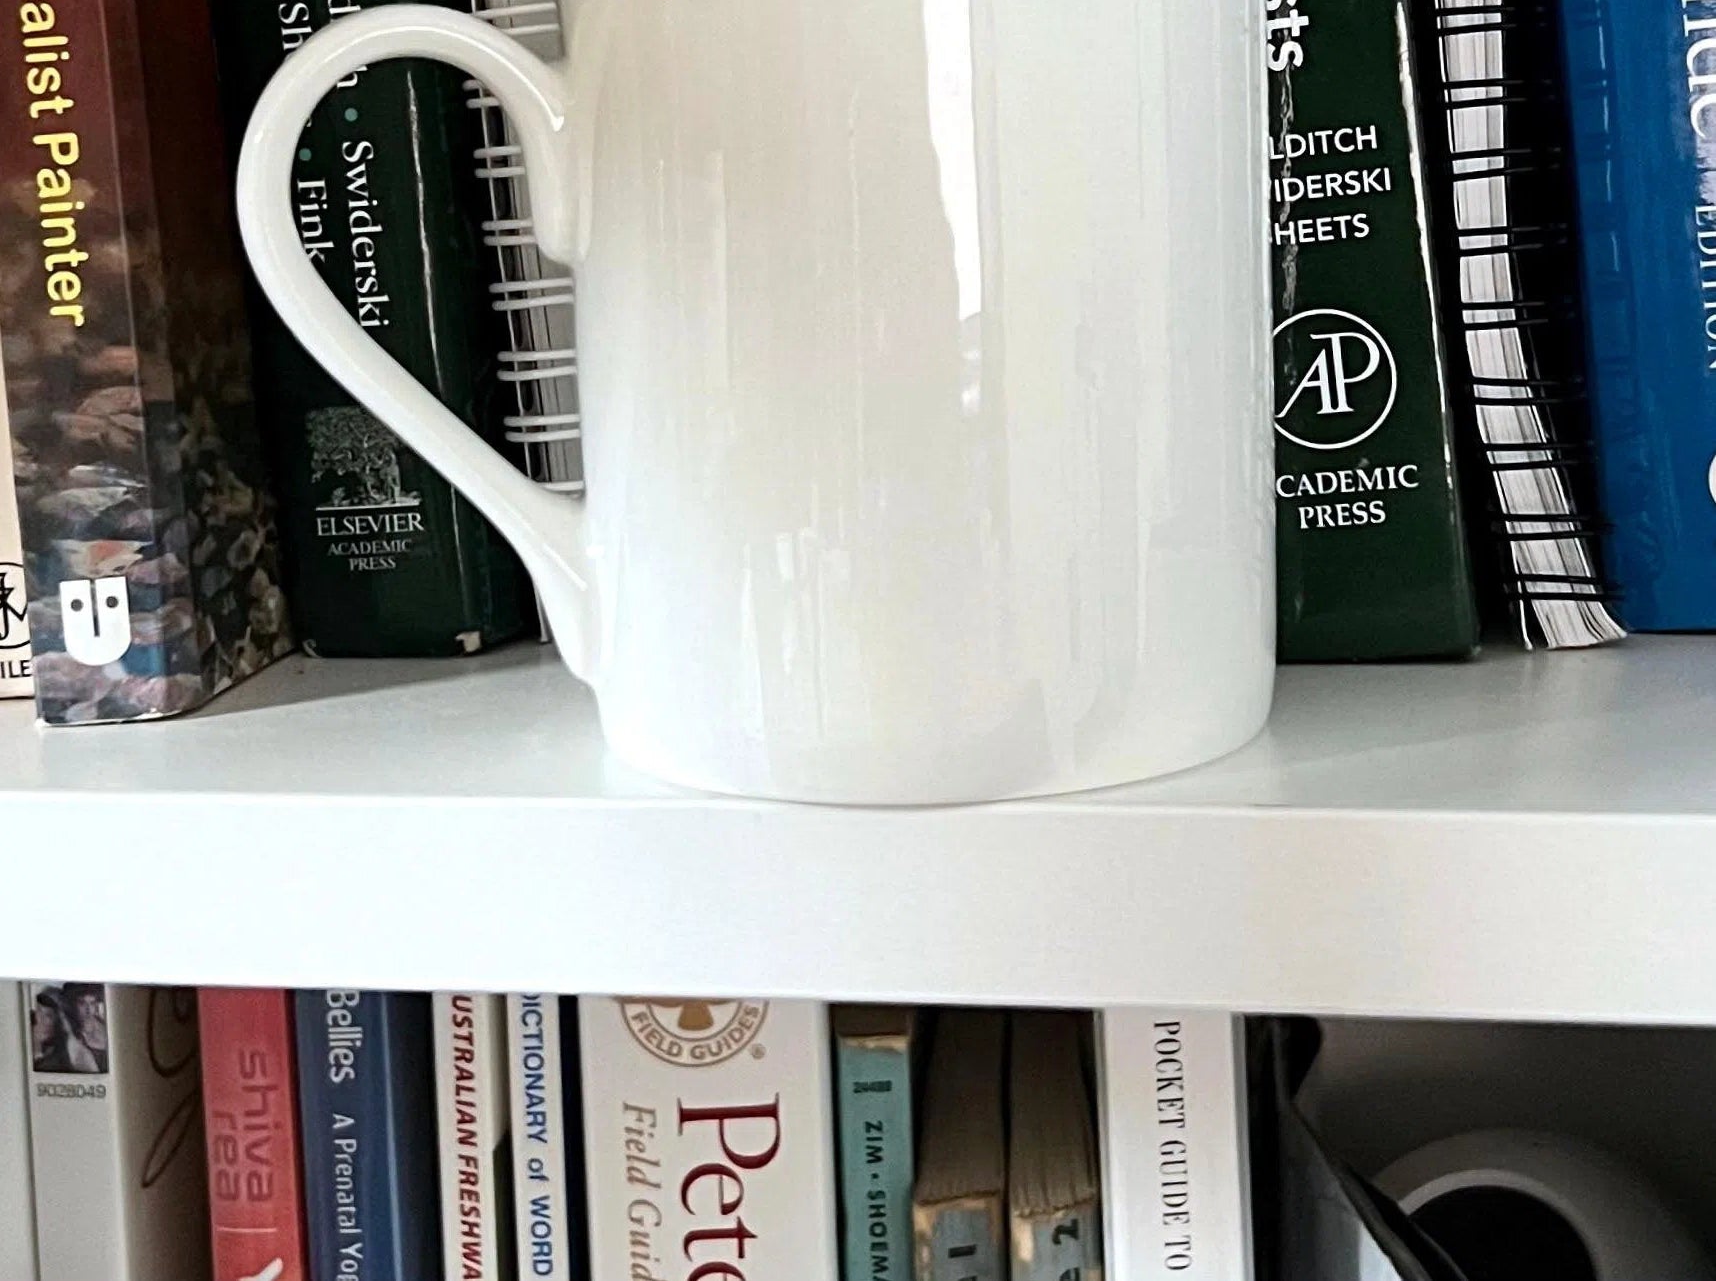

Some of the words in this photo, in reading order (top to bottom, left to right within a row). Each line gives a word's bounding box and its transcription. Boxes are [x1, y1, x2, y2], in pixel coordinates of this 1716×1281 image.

[1269, 124, 1378, 160] LDITCH
[32, 132, 90, 327] Painter
[297, 179, 335, 264] Fink
[341, 140, 391, 327] Swiderski
[1275, 331, 1381, 419] AP
[1276, 464, 1420, 498] CADEMIC
[1298, 500, 1387, 530] PRESS
[316, 512, 424, 536] ELSEVIER
[327, 539, 413, 557] ACADEMIC
[348, 556, 397, 572] PRESS
[325, 989, 364, 1084] Bellies
[451, 994, 478, 1147] USTRALIAN
[631, 1010, 684, 1058] FIELD
[688, 1004, 761, 1060] GUIDES
[1153, 1020, 1186, 1130] POCKET
[211, 1109, 240, 1203] rea
[238, 1048, 282, 1203] shiva
[331, 1113, 356, 1130] A
[621, 1101, 663, 1191] Field
[864, 1120, 885, 1166] ZIM
[333, 1137, 364, 1235] Prenatal
[527, 1157, 550, 1182] of
[1158, 1139, 1191, 1227] GUIDE
[457, 1153, 483, 1280] FRESHWA
[529, 1194, 554, 1277] WORD
[1163, 1234, 1193, 1271] TO
